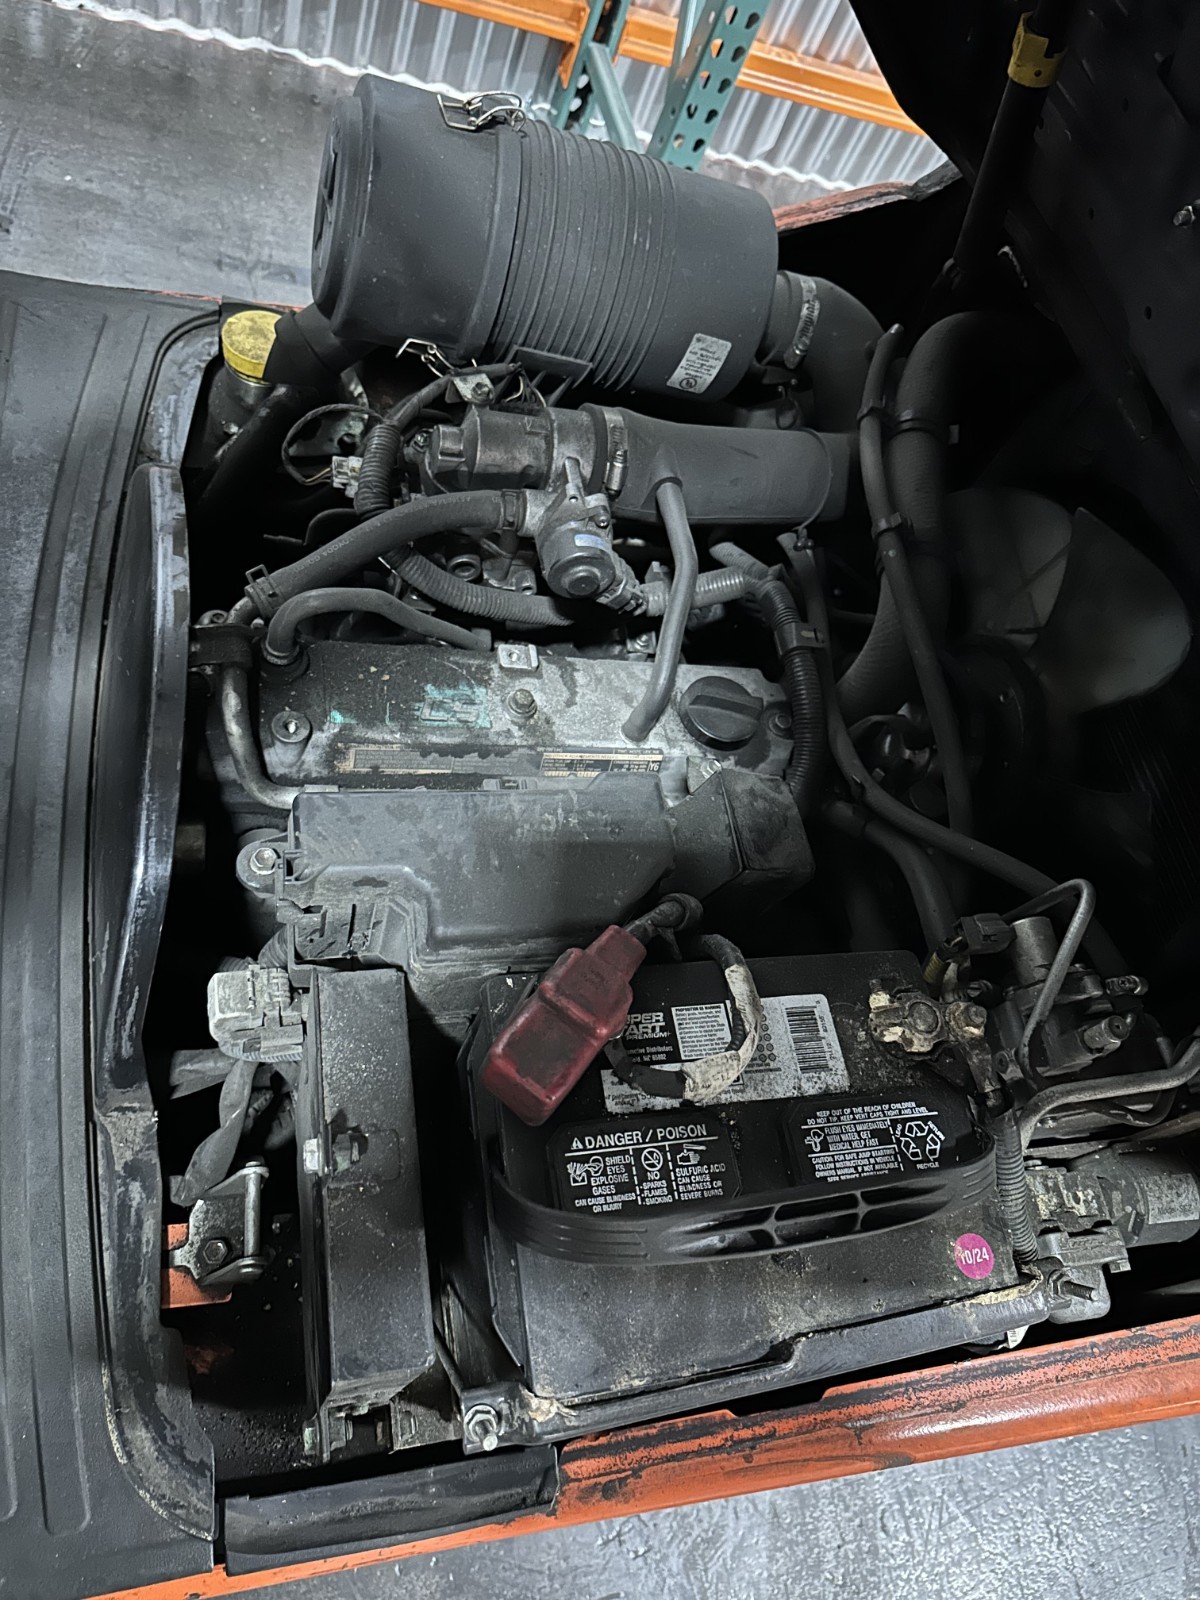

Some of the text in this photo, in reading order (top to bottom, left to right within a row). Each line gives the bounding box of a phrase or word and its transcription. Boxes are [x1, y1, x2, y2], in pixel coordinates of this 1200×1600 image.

[650, 762, 660, 771] Y6
[626, 1012, 664, 1025] PER
[624, 1022, 666, 1037] ART
[852, 1106, 863, 1114] THE
[824, 1120, 888, 1134] FLUSH EYES IMMEDIATELY
[927, 1121, 945, 1141] RETURN
[585, 1131, 642, 1149] DANGER
[656, 1124, 707, 1140] POISON
[826, 1134, 840, 1142] WITH
[860, 1131, 871, 1139] GET
[829, 1138, 879, 1151] MEDICAL HELP FAST
[872, 1149, 895, 1157] STARTING
[605, 1155, 630, 1166] SHIELD
[835, 1159, 869, 1168] INSTRUCTIONS
[875, 1162, 898, 1170] AVAILABLE
[916, 1162, 939, 1170] RECYCLE
[606, 1165, 626, 1174] EYES
[676, 1163, 726, 1176] SULFURIC ACID
[590, 1173, 629, 1186] EXPLOSIVE
[647, 1171, 660, 1180] NO
[677, 1174, 711, 1184] CAN CAUSE
[592, 1185, 616, 1196] GASES
[642, 1180, 667, 1190] SPARKS
[678, 1180, 722, 1192] BLINDNESS OR
[644, 1188, 668, 1197] FLAMES
[680, 1188, 723, 1200] SEVERE BURNS
[575, 1193, 636, 1207] CAN CAUSE BLINDNESS
[645, 1195, 672, 1205] SMOKING
[592, 1202, 622, 1213] OR INJURY
[960, 1246, 990, 1265] 10/24
